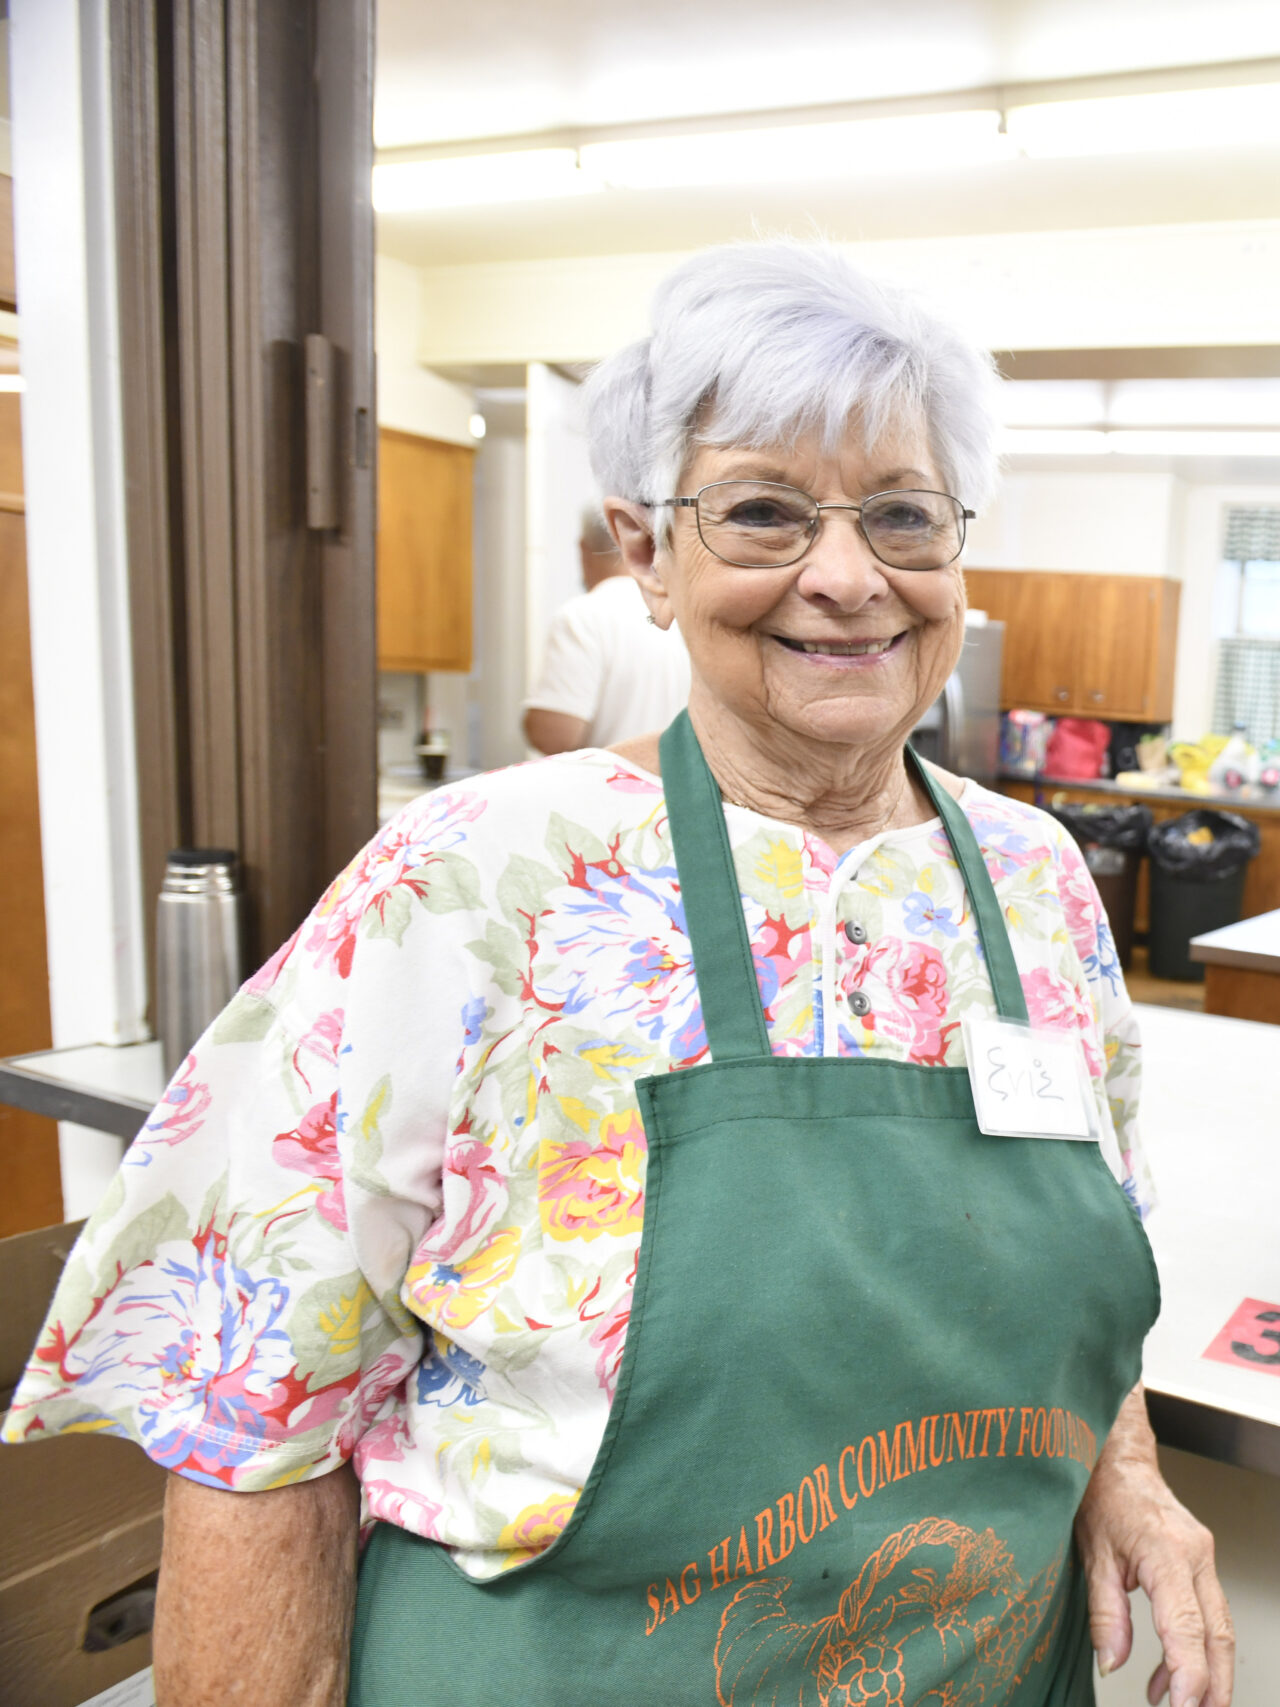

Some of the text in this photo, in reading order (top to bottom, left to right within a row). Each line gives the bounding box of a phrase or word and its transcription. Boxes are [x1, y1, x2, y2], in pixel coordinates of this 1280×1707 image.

[645, 1560, 702, 1636] SAG
[707, 1464, 839, 1592] HARBOR
[838, 1407, 1015, 1510] COMMUNITY
[1015, 1407, 1066, 1459] FOOD
